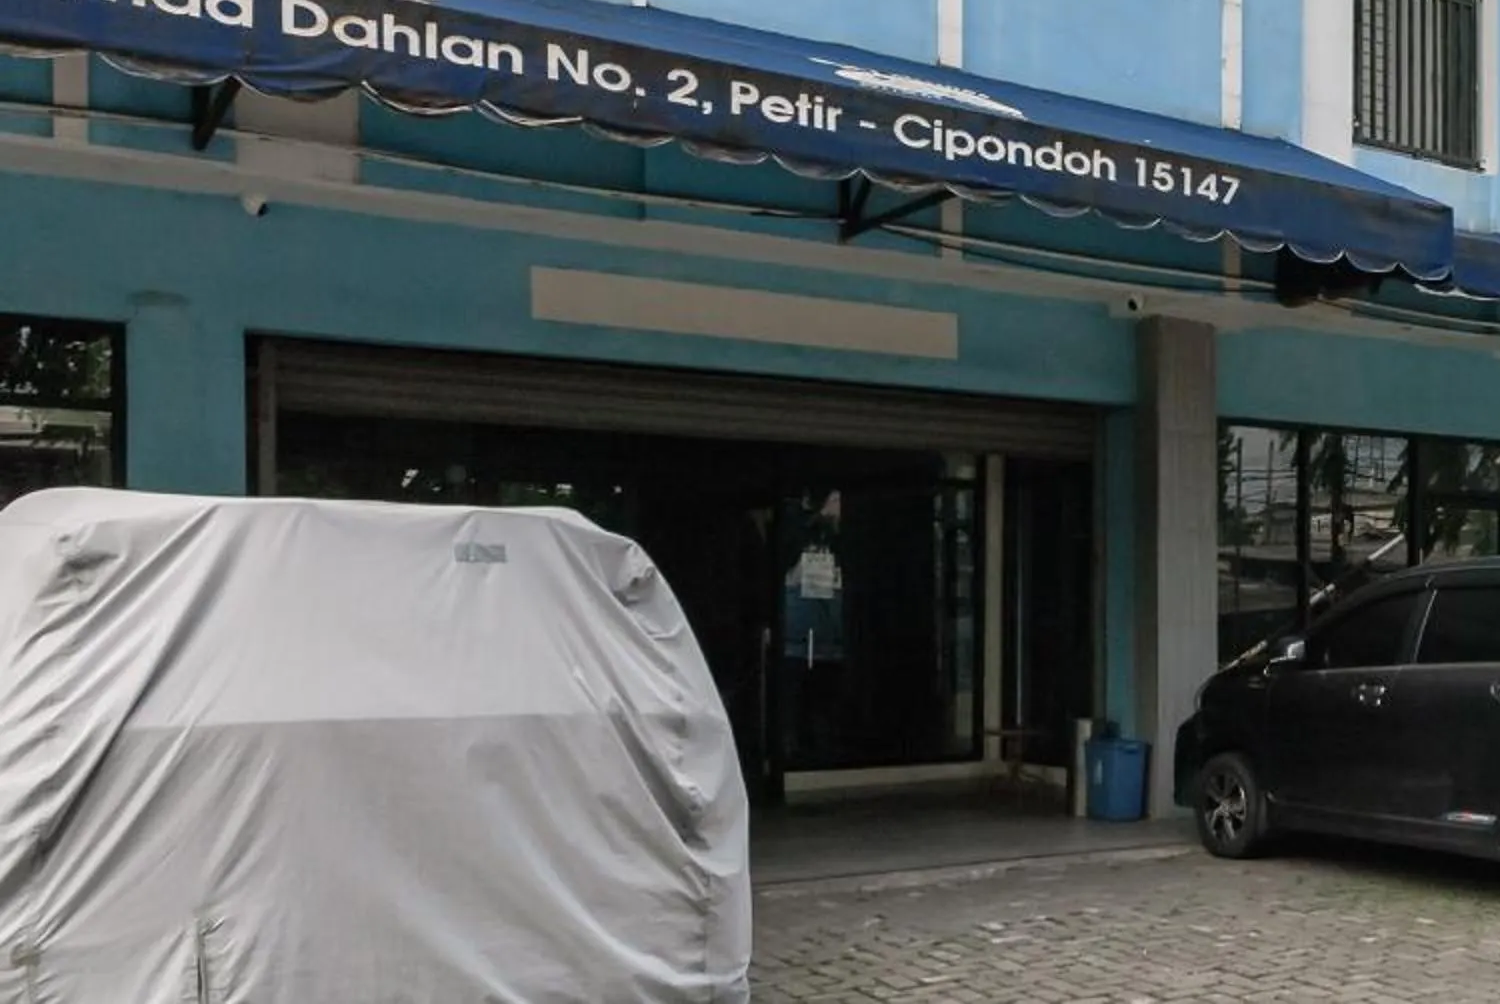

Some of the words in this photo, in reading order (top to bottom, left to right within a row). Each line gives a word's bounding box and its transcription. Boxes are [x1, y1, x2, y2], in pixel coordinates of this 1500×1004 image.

[547, 43, 645, 96] No.
[666, 68, 713, 115] 2,
[730, 81, 842, 132] Petir
[859, 118, 877, 130] -
[893, 113, 1118, 182] Cipondoh
[1136, 157, 1241, 206] 15147
